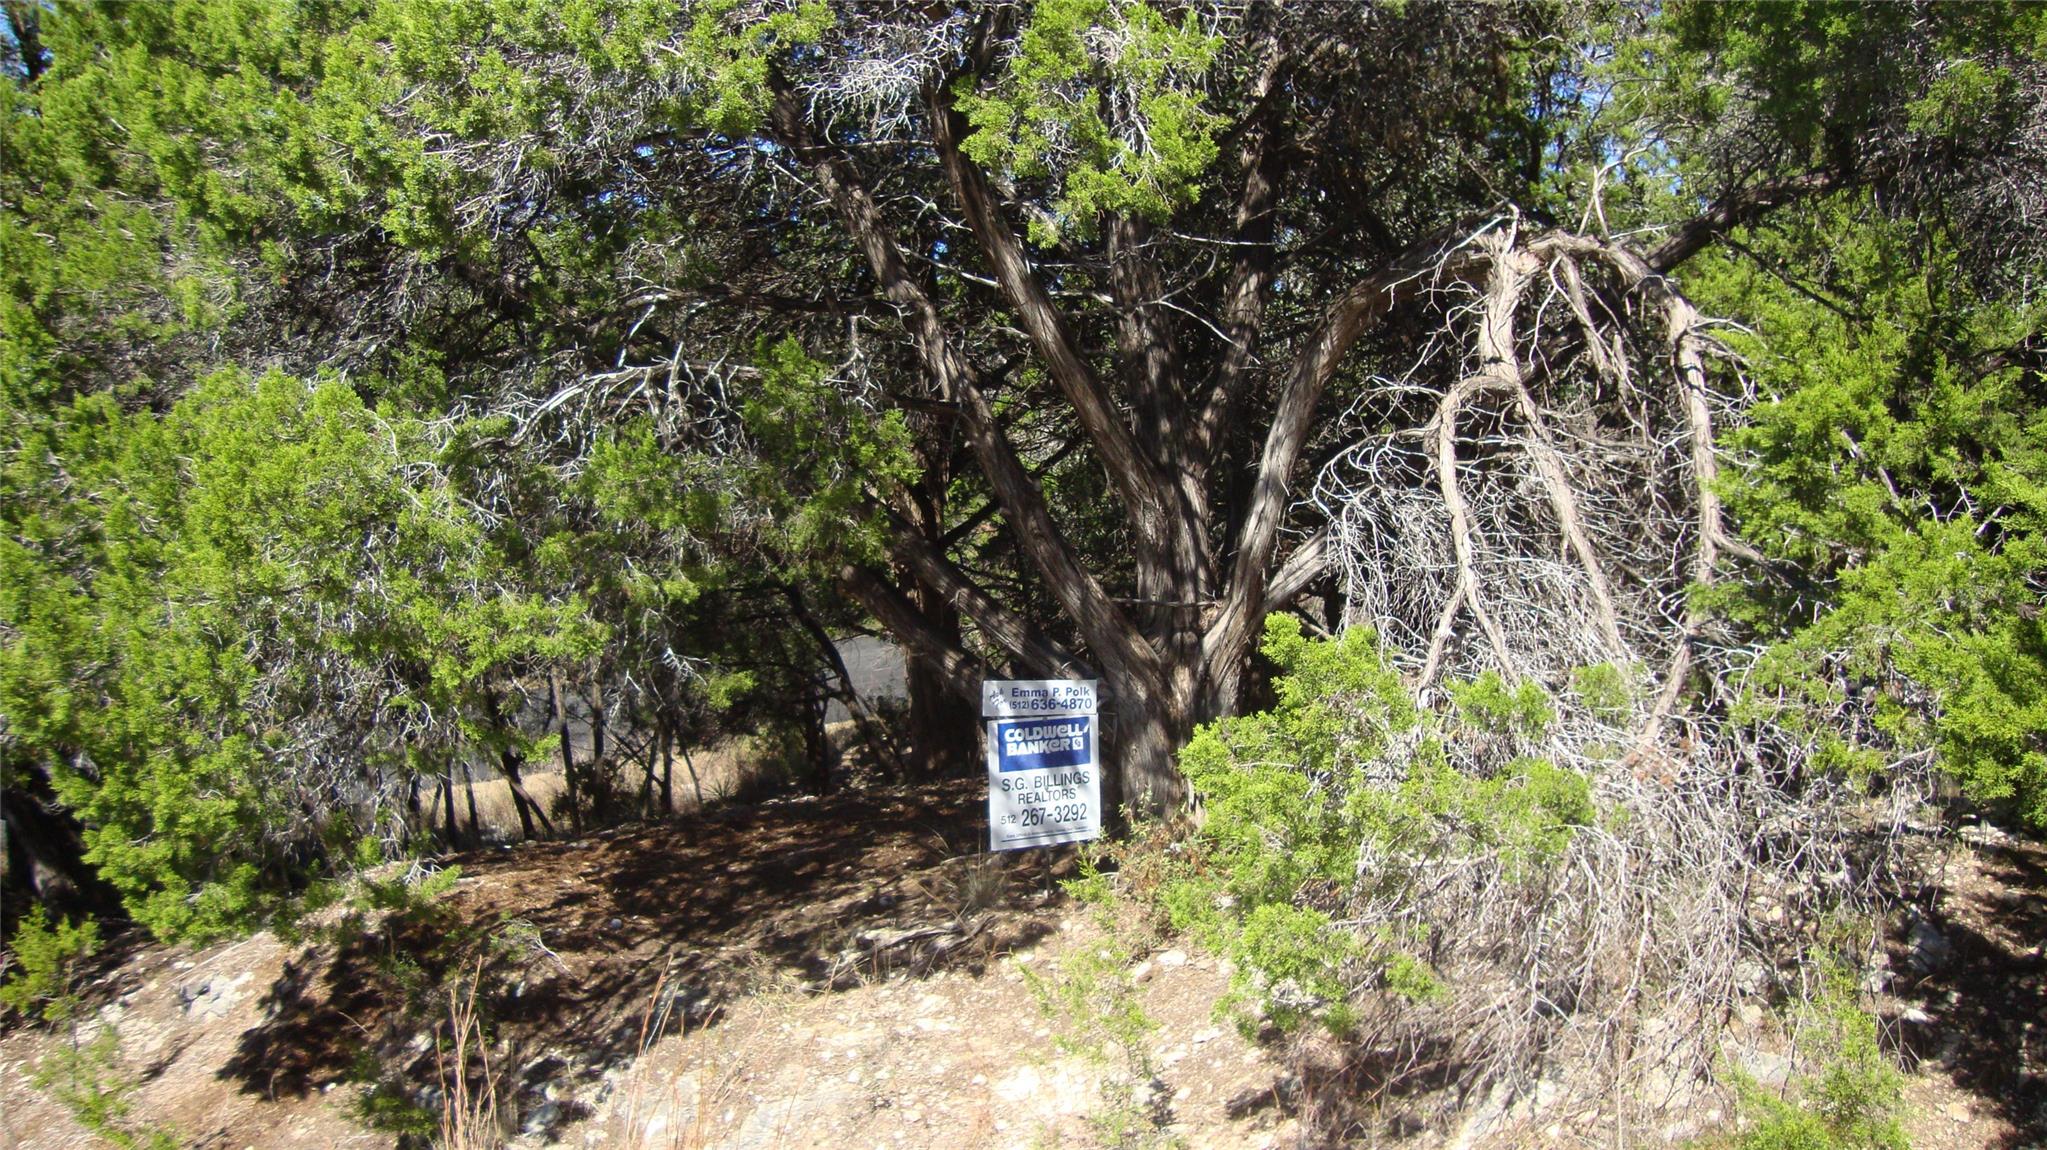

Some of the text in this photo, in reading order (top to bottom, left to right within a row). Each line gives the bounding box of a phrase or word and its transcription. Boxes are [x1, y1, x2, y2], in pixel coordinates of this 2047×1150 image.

[1011, 687, 1048, 698] Emma
[1053, 687, 1062, 697] P.
[1065, 686, 1090, 697] Polk
[1009, 698, 1092, 710] (512) 636-4870
[1004, 723, 1083, 742] COLDWELL
[1006, 738, 1070, 756] BANKER
[1001, 771, 1090, 792] S.G. BILLINGS
[1018, 788, 1076, 804] REALTORS
[1000, 803, 1087, 827] 512 267-3292
